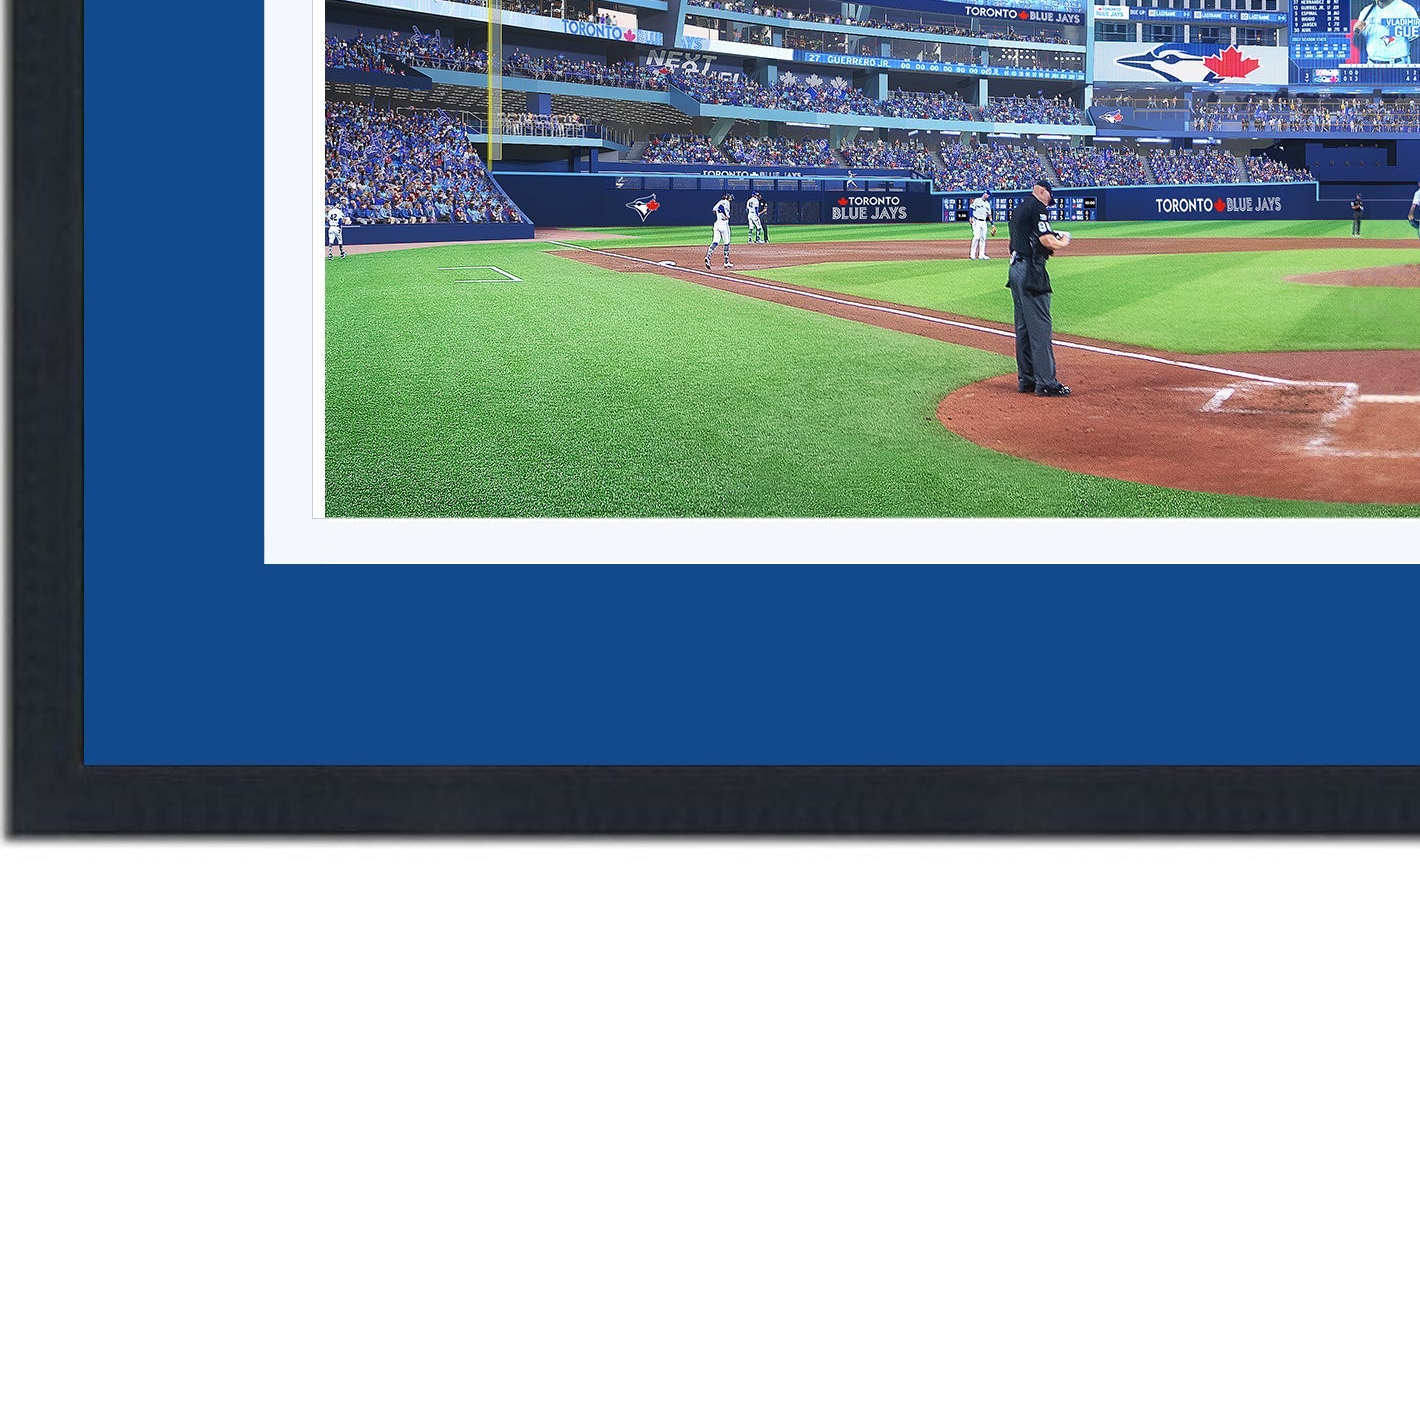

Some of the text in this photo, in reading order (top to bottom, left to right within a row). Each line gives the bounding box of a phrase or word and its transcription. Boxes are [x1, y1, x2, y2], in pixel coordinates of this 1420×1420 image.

[965, 6, 1080, 24] TORONTO BLUE JAYS
[562, 19, 622, 40] TORONTO
[828, 55, 876, 66] GUERRERO
[848, 197, 900, 206] TORONTO
[1156, 197, 1282, 212] TORONTO BLUE JAYS
[832, 207, 908, 220] BLUE JAYS
